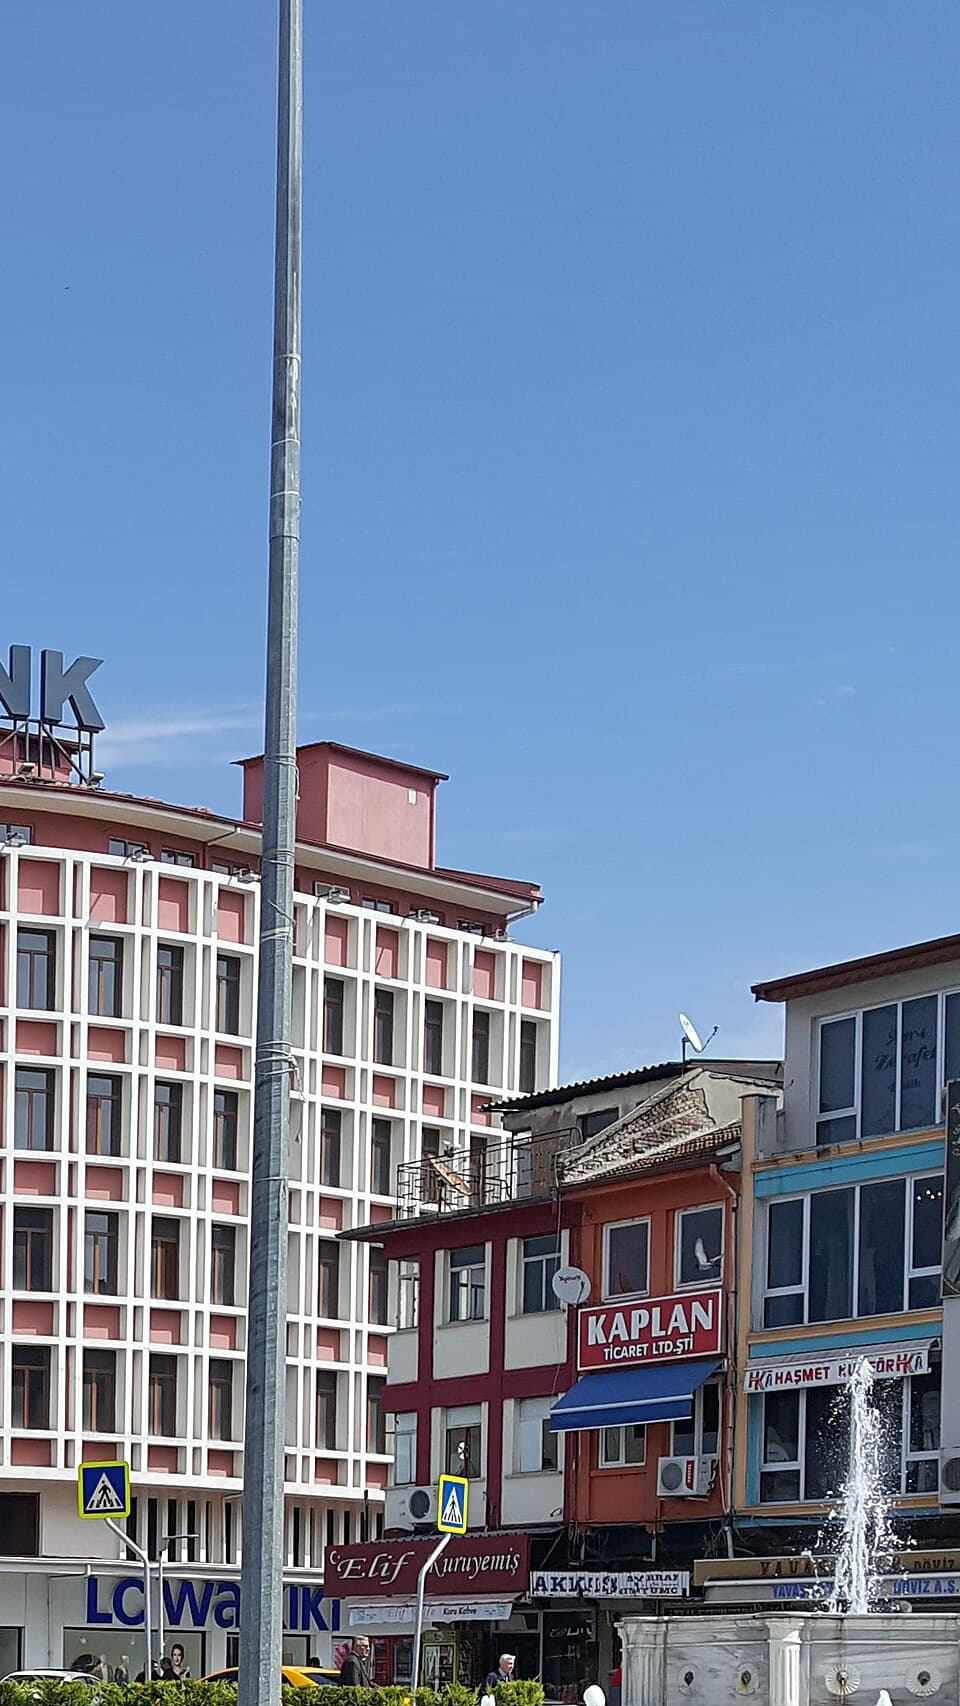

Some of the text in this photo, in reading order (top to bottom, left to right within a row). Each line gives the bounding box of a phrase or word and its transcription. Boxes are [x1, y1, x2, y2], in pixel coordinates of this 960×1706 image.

[587, 1299, 713, 1346] KAPLAN
[603, 1334, 694, 1361] TİCARET LTD.ŞTİ
[775, 1366, 831, 1386] HAŞMET
[838, 1357, 896, 1380] KUFÖR
[336, 1547, 521, 1585] Elif Kuruyemiş
[86, 1576, 146, 1625] LC
